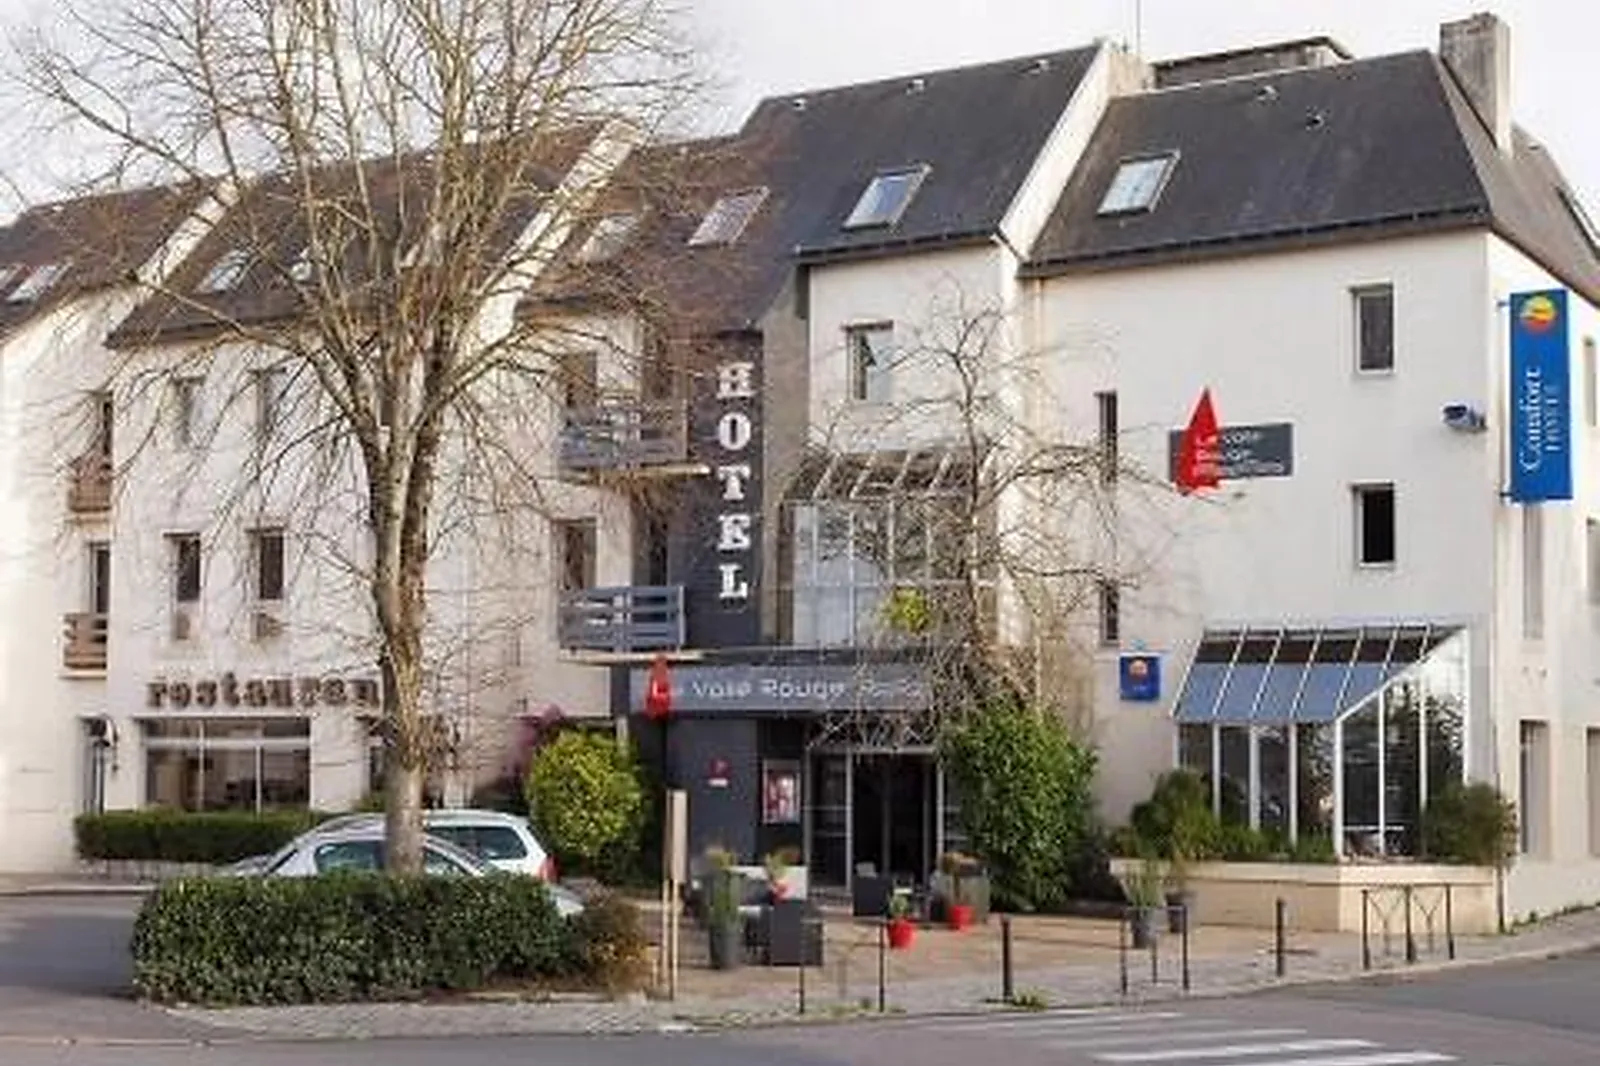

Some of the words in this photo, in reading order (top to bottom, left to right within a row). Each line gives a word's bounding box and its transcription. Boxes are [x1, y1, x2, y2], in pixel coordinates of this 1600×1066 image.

[716, 362, 753, 598] HOTEL
[147, 672, 384, 709] restauran
[760, 678, 845, 700] Rouge
